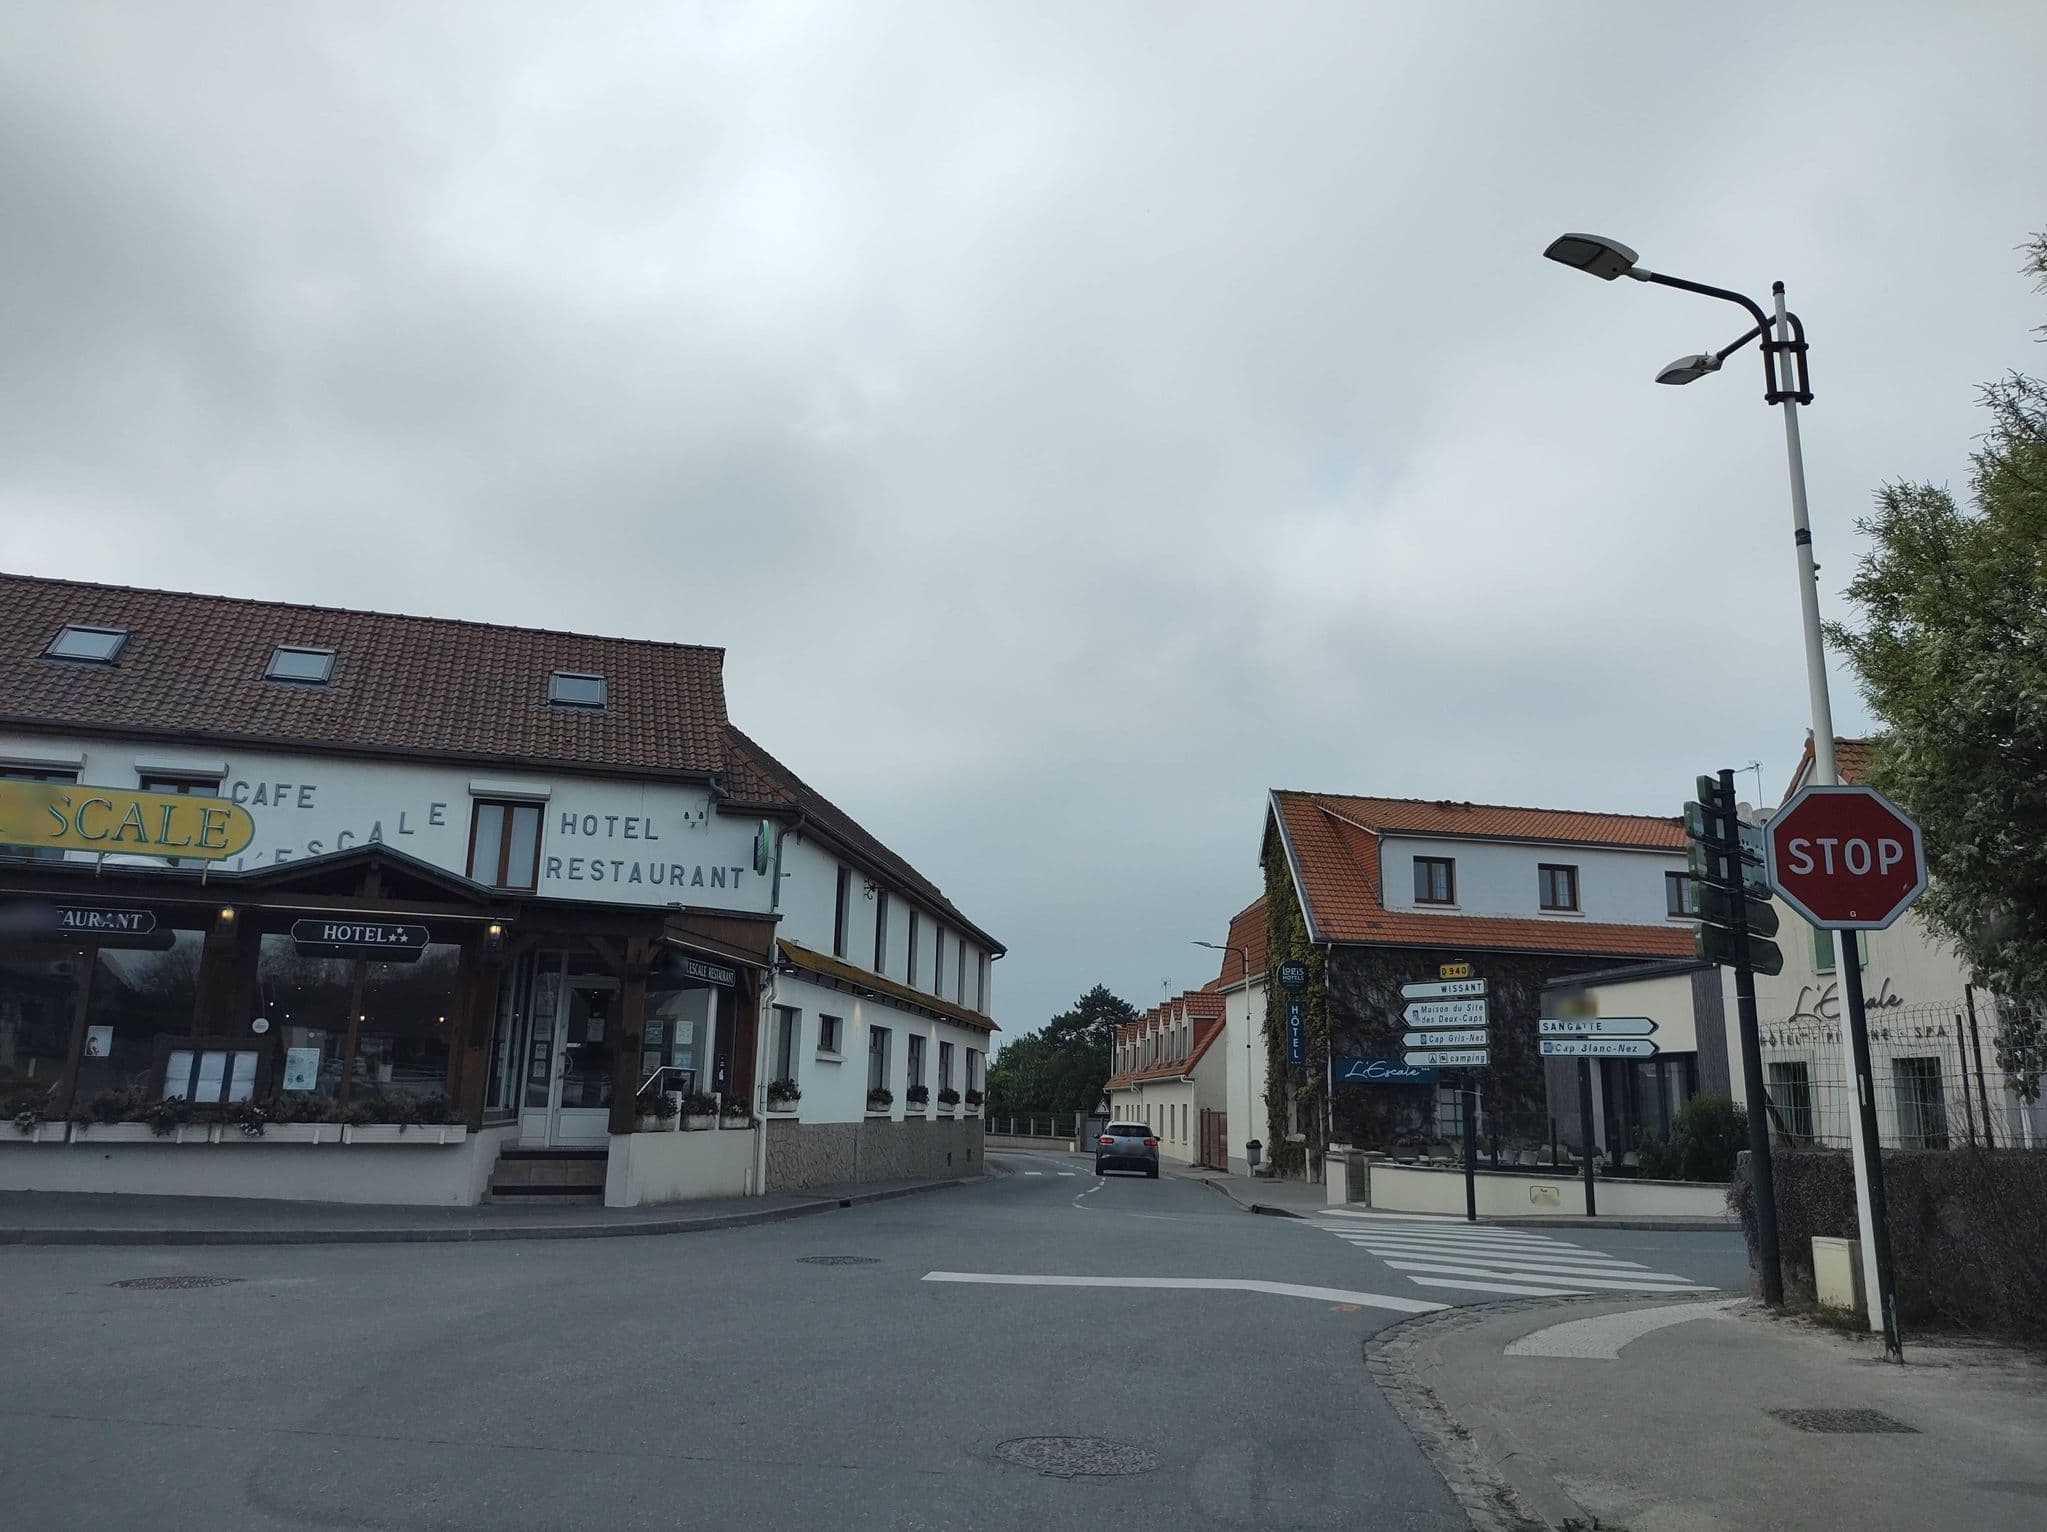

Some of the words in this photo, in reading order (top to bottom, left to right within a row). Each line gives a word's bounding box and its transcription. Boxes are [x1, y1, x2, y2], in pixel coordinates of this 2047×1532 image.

[232, 780, 317, 808] CAFE
[561, 812, 659, 840] HOTEL
[1788, 838, 1903, 876] STOP
[546, 856, 744, 889] RESTAURANT
[57, 910, 143, 929] AURANT
[323, 925, 387, 942] HOTEL
[1441, 967, 1447, 976] D
[1449, 966, 1467, 975] 940
[1441, 983, 1482, 993] WISSANT
[1421, 1005, 1449, 1014] Maison
[1453, 1004, 1463, 1012] du
[1467, 1003, 1484, 1012] Site
[1788, 977, 1904, 1023] L'Eale
[1421, 1015, 1435, 1024] des
[1438, 1013, 1483, 1023] Deux-Caps
[1290, 1005, 1300, 1058] HÔTEL
[1429, 1034, 1444, 1043] Cap
[1448, 1033, 1484, 1042] Gris-Nez
[1914, 1025, 1948, 1038] SPA
[1555, 1043, 1575, 1053] Cap
[1450, 1052, 1485, 1064] camping
[1345, 1060, 1420, 1079] L'Escale
